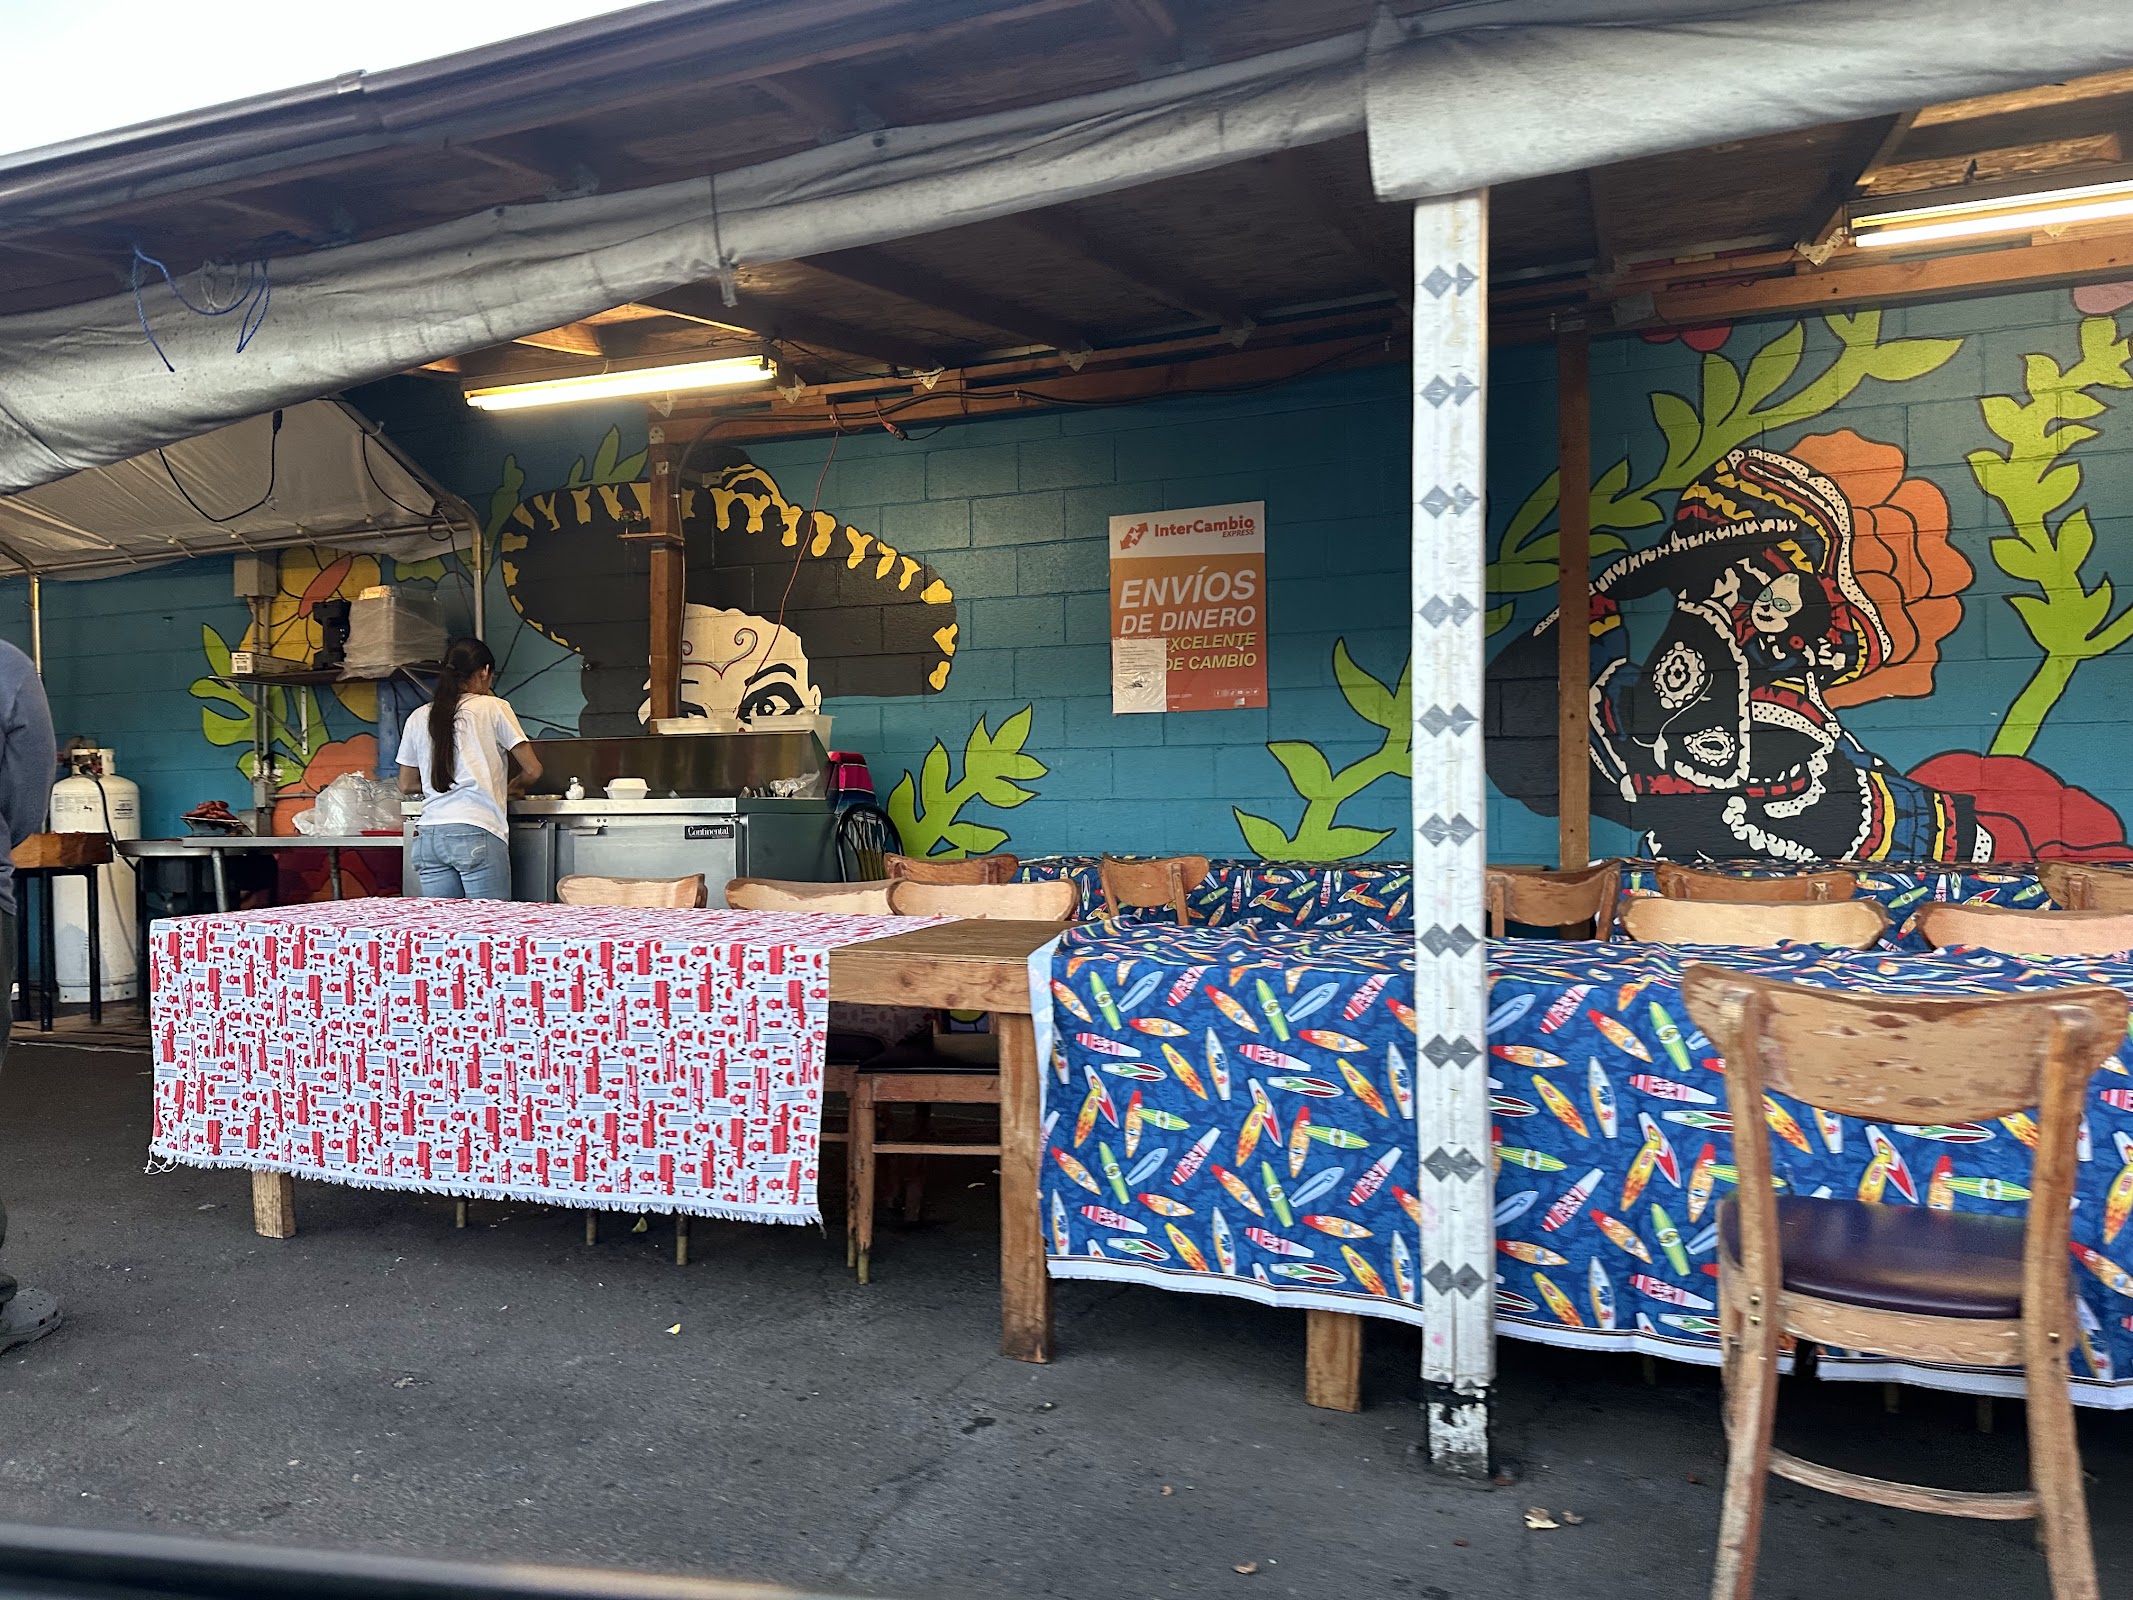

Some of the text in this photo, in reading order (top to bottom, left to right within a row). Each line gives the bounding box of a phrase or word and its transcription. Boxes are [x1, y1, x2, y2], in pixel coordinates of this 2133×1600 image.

[1154, 515, 1254, 537] InterCambio
[1222, 529, 1254, 538] EXPRESS
[1119, 565, 1257, 609] ENVÍOS
[1120, 605, 1256, 635] DE DINERO
[1188, 653, 1257, 670] CAMBIO
[687, 826, 729, 837] Continental
